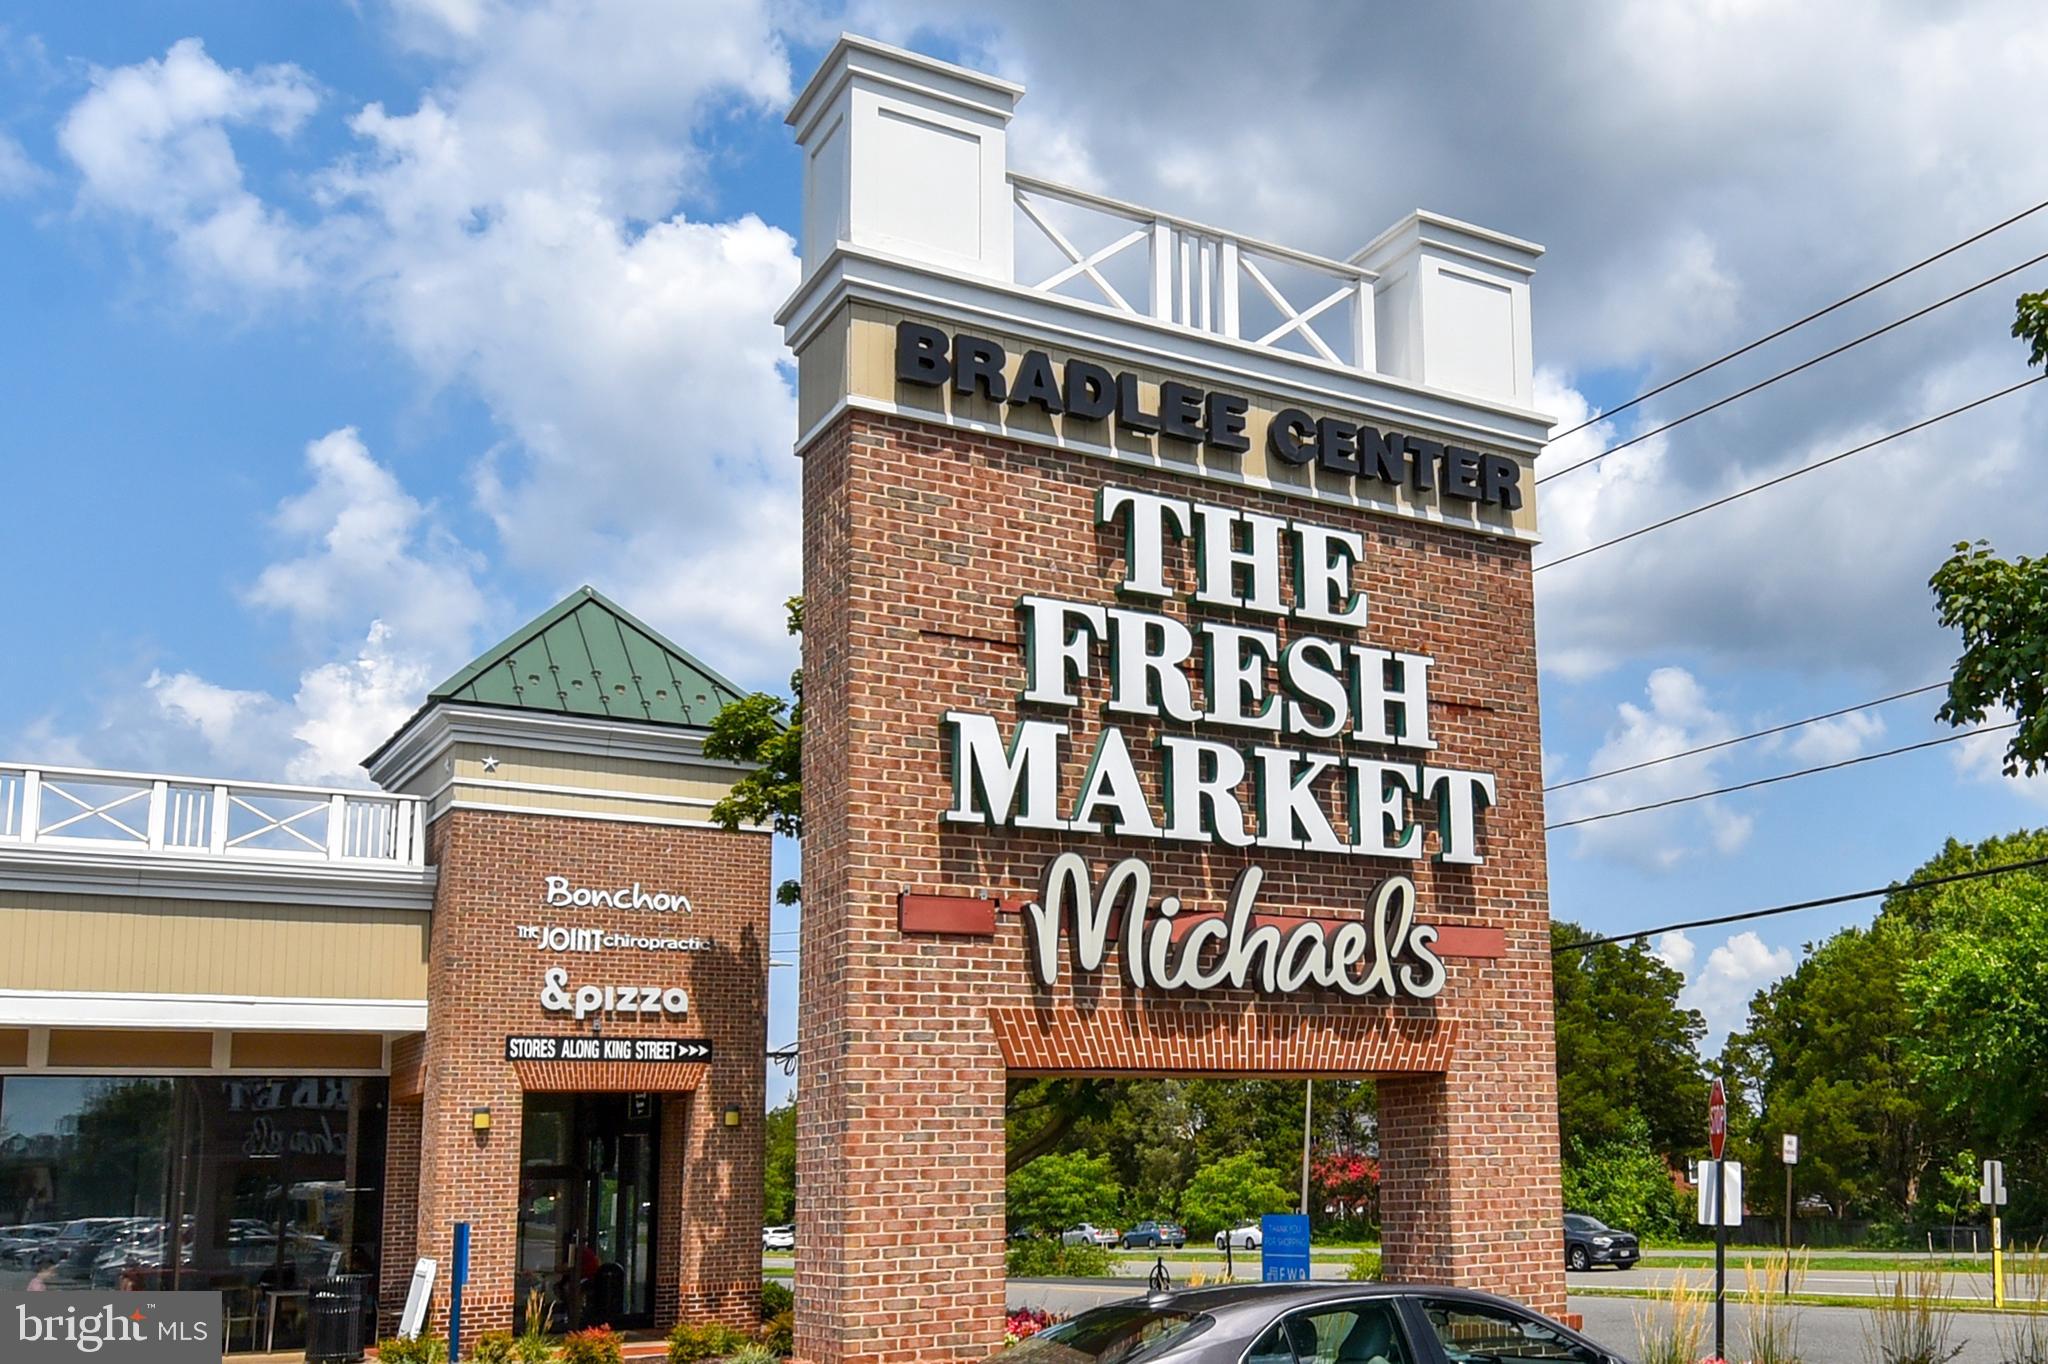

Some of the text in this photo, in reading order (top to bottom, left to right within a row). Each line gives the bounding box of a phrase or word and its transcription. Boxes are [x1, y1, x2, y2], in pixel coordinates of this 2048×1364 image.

[895, 319, 1523, 511] BRADLEE CENTER
[1095, 485, 1368, 629] THE
[1015, 593, 1439, 752] FRESH
[940, 710, 1498, 866] MARKET
[538, 927, 605, 952] JOINT
[602, 934, 713, 951] chiropractic
[544, 875, 692, 914] Bonchon
[1021, 850, 1448, 999] Michaels
[508, 1037, 678, 1061] STORES ALONG KING STREET
[540, 966, 690, 1020] &pizza
